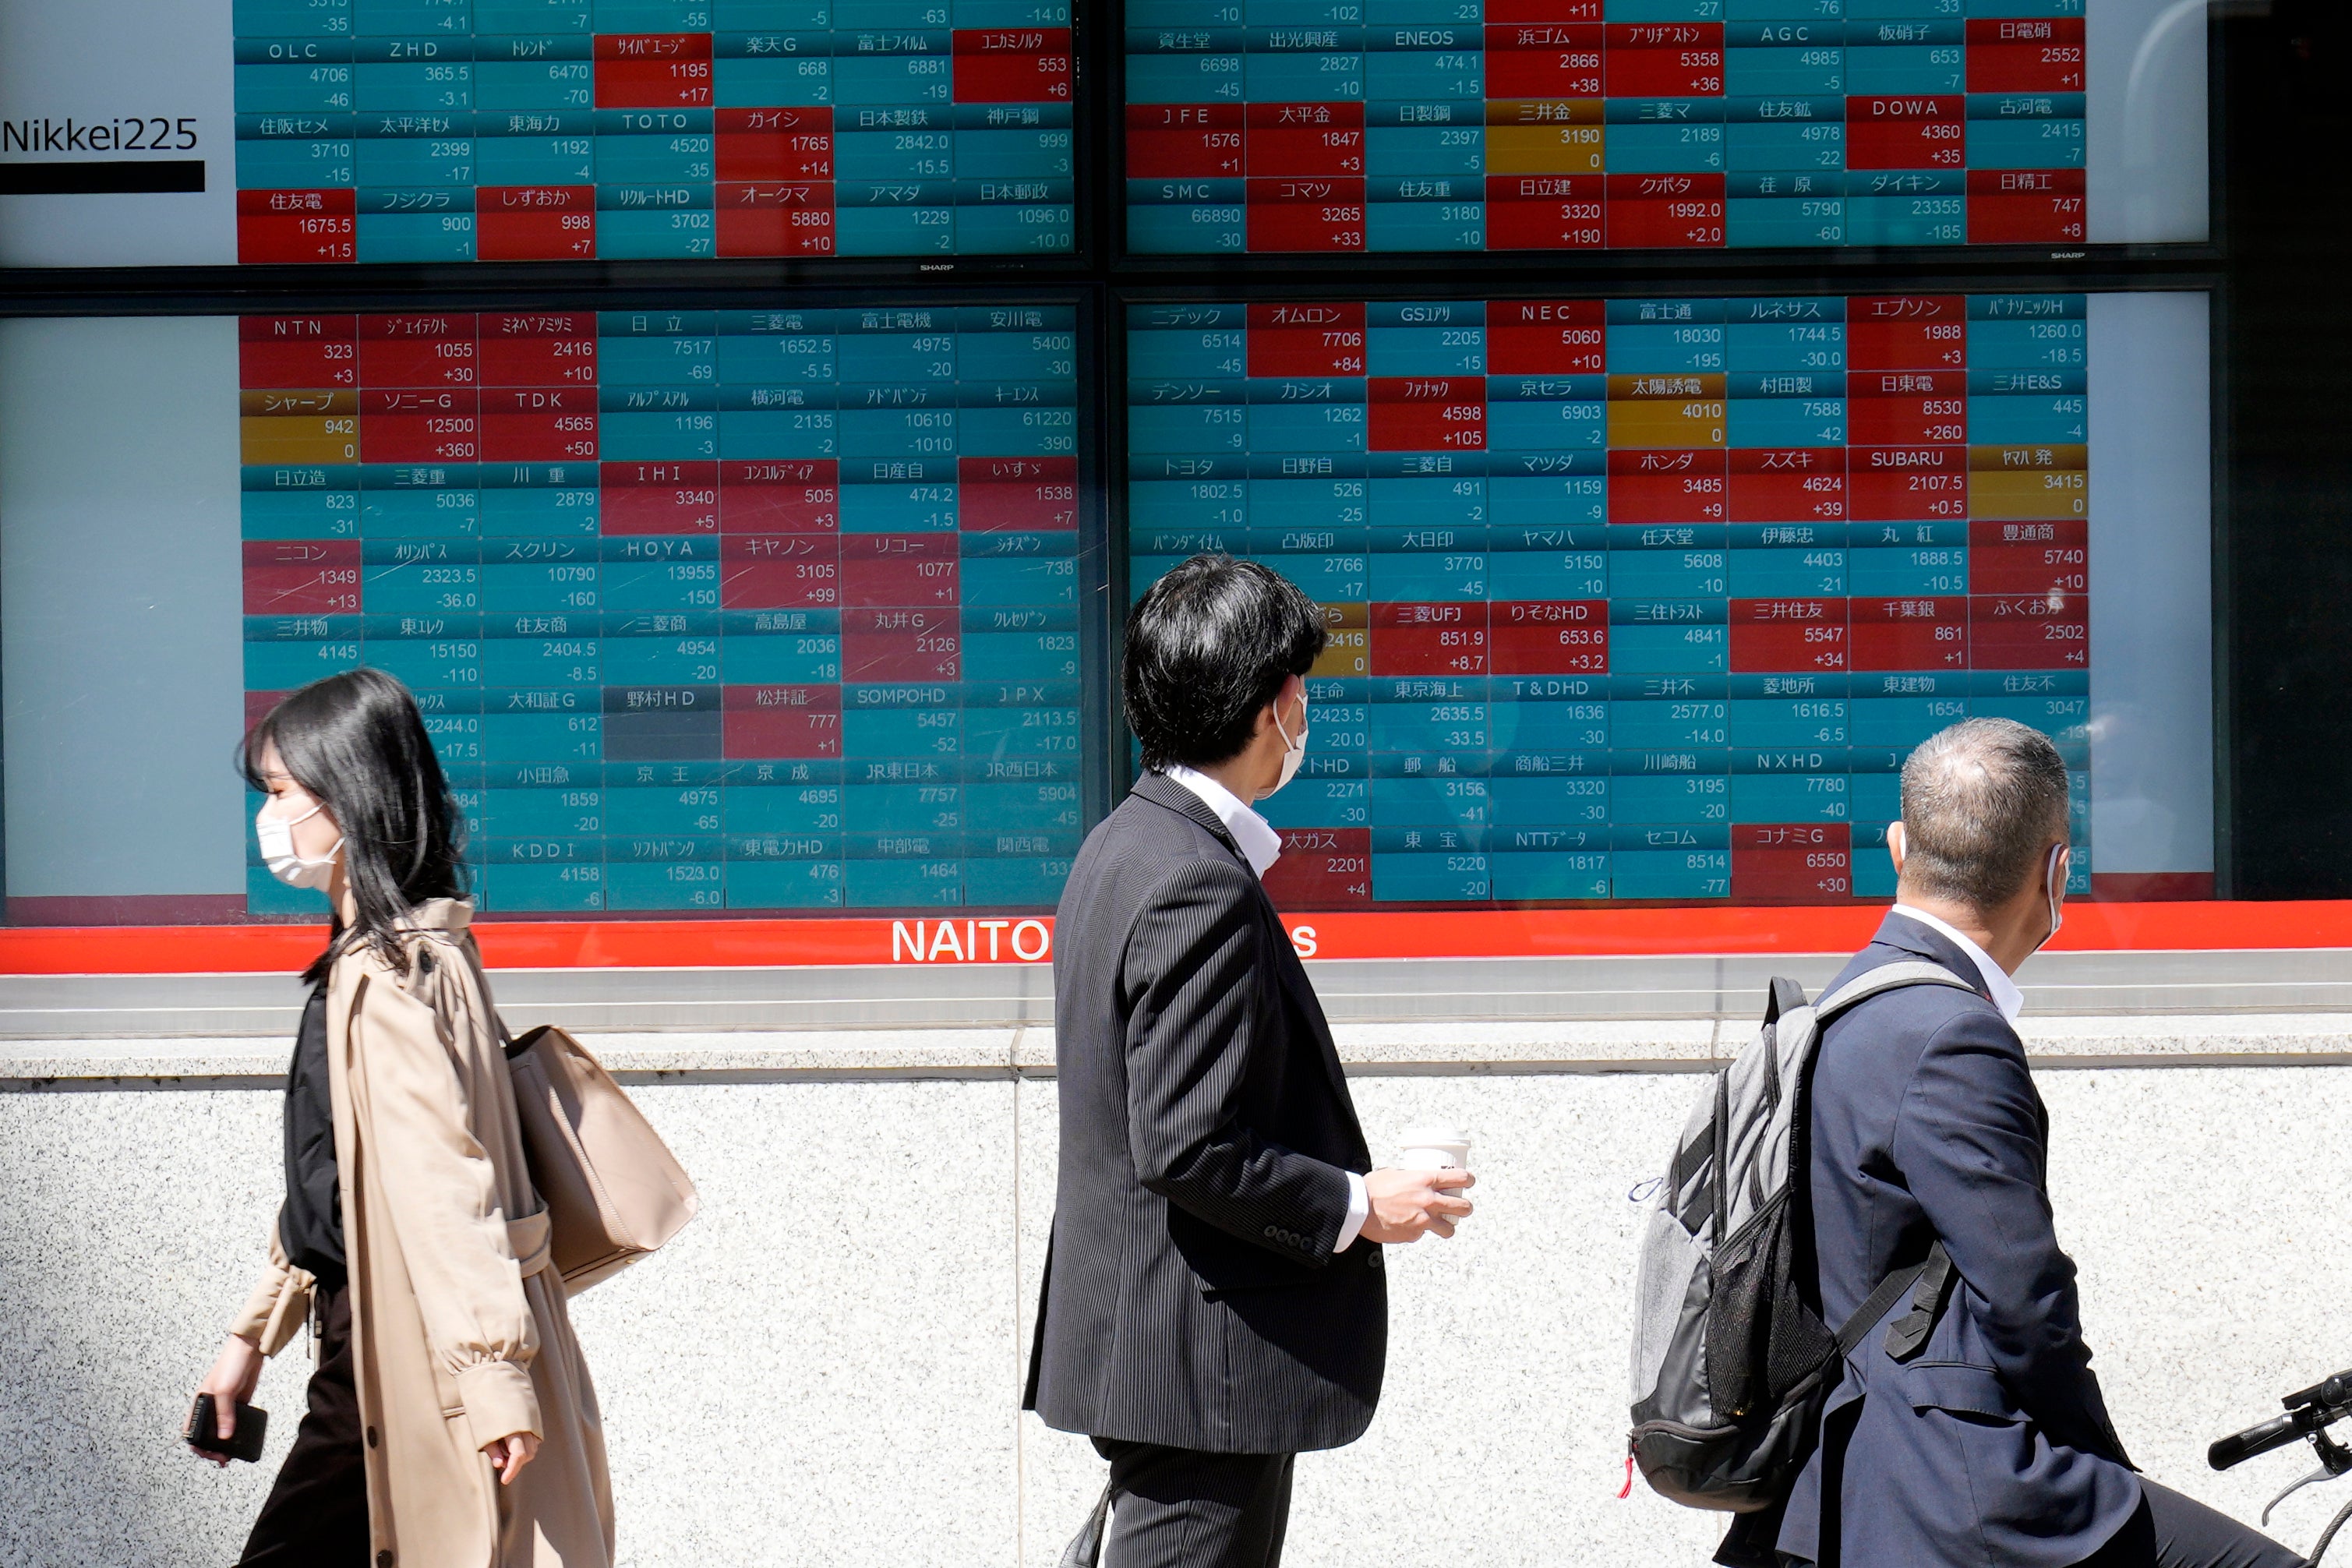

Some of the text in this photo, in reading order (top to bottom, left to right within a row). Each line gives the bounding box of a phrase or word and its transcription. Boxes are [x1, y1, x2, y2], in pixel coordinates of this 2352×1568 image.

[1213, 7, 1239, 22] -10
[1693, 1, 1718, 16] -27
[682, 12, 708, 27] -55
[1395, 30, 1454, 46] ENEOS
[1517, 27, 1570, 45] 浜ゴム
[1877, 24, 1930, 41] 板硝子
[2000, 22, 2051, 39] 日電硝
[747, 36, 796, 54] 楽天G
[1158, 32, 1210, 49] 資生堂
[1270, 30, 1338, 48] 出光興産
[1680, 51, 1719, 67] 5358
[2041, 48, 2080, 63] 2552
[798, 61, 827, 76] 668
[1320, 56, 1359, 72] 2827
[425, 65, 468, 81] 365.5
[1449, 79, 1479, 94] -1.5
[439, 91, 467, 106] -3.1
[2000, 98, 2053, 115] 古河電
[1519, 102, 1571, 121] 三井金
[1758, 101, 1812, 118] 住友鉱
[1873, 100, 1938, 115] DOWA
[747, 111, 800, 129] ガイシ
[860, 109, 928, 127] 日本製鉄
[986, 108, 1039, 125] 神戸鋼
[259, 118, 328, 135] 住阪セメ
[1801, 126, 1841, 141] 4978
[3, 118, 197, 152] Nikkei225
[1039, 133, 1068, 148] 999
[1440, 130, 1479, 146] 2397
[311, 143, 350, 158] 3710
[669, 138, 709, 153] 4520
[1931, 149, 1961, 164] +35
[325, 167, 350, 182] -15
[2001, 173, 2052, 190] 日精工
[1280, 182, 1331, 198] コマツ
[1398, 181, 1451, 198] 住友重
[1520, 178, 1571, 196] 日立建
[1640, 176, 1691, 194] クボタ
[1870, 174, 1941, 192] ダイキン
[503, 189, 571, 207] しずおか
[740, 186, 810, 203] オークマ
[870, 185, 920, 202] アマダ
[980, 183, 1048, 200] 日本郵政
[269, 192, 323, 210] 住友電
[383, 192, 450, 209] フジクラ
[1912, 200, 1961, 215] 23355
[912, 210, 950, 225] 1229
[1191, 208, 1241, 223] 66890
[1561, 203, 1601, 220] 3320
[561, 215, 591, 230] 998
[1686, 227, 1721, 242] +2.0
[317, 242, 351, 258] +1.5
[1271, 306, 1341, 324] オムロン
[1640, 302, 1693, 320] 富士通
[1871, 298, 1941, 316] エプソン
[750, 313, 803, 330] 三菱電
[861, 312, 931, 329] 富士電機
[991, 310, 1043, 327] 安川電
[1673, 328, 1721, 343] 18030
[2029, 323, 2082, 339] 1260.0
[779, 338, 832, 354] 1652.5
[1322, 332, 1361, 347] 7706
[435, 342, 473, 358] 1055
[1332, 356, 1361, 372] +84
[1801, 351, 1841, 366] -30.0
[563, 366, 593, 381] +10
[1281, 382, 1333, 399] カシオ
[1520, 380, 1572, 397] 京セラ
[1631, 377, 1702, 395] 太陽誘電
[1760, 376, 1812, 394] 村田製
[1882, 374, 1934, 393] 日東電
[750, 389, 804, 406] 横河電
[1153, 383, 1221, 401] デンソー
[384, 394, 451, 409] ソニーG
[1803, 402, 1842, 417] 7588
[1022, 411, 1072, 426] 61220
[1442, 405, 1481, 421] 4598
[324, 418, 354, 434] 942
[675, 415, 713, 430] 1196
[1923, 425, 1962, 440] +260
[435, 442, 475, 457] +360
[1166, 458, 1213, 475] トヨタ
[1282, 457, 1332, 474] 日野自
[1401, 454, 1452, 473] 三菱自
[1523, 454, 1573, 472] マツダ
[1640, 452, 1694, 470] ホンダ
[1760, 450, 1813, 468] スズキ
[1871, 451, 1943, 467] SUBARU
[275, 469, 327, 486] 日立造
[394, 468, 447, 485] 三菱重
[874, 461, 923, 479] 日産自
[1565, 480, 1602, 495] 1159
[1909, 475, 1963, 491] 2107.5
[676, 490, 715, 505] 3340
[1035, 486, 1073, 500] 1538
[1191, 484, 1242, 500] 1802.5
[1928, 500, 1963, 514] +0.5
[330, 519, 353, 534] -31
[2003, 523, 2054, 541] 豊通商
[1282, 531, 1334, 549] 凸版印
[1523, 530, 1575, 546] ヤマハ
[1640, 528, 1694, 546] 任天堂
[1760, 527, 1814, 545] 伊藤忠
[505, 542, 575, 559] スクリン
[745, 539, 814, 556] キヤノン
[1564, 555, 1603, 570] 5150
[1911, 550, 1963, 566] 1888.5
[916, 562, 955, 577] 1077
[1817, 577, 1841, 592] -21
[680, 589, 716, 605] -150
[1397, 606, 1461, 623] 三菱UFJ
[1511, 605, 1587, 621] りそなHD
[1753, 602, 1823, 620] 三井住友
[515, 616, 567, 634] 住友商
[1559, 630, 1604, 645] 653.6
[1934, 626, 1962, 641] 861
[542, 641, 596, 657] 2404.5
[810, 663, 836, 679] -18
[1644, 679, 1695, 696] 三井不
[1763, 676, 1815, 694] 菱地所
[1882, 676, 1935, 694] 東建物
[508, 691, 575, 709] 大和証G
[857, 687, 945, 704] SOMPOHD
[1566, 705, 1605, 720] 1636
[568, 715, 599, 732] 612
[1444, 730, 1489, 747] -33.5
[1644, 754, 1697, 771] 川崎船
[517, 765, 570, 785] 小田急
[1446, 781, 1487, 797] 3156
[1806, 777, 1845, 793] 7780
[560, 792, 599, 807] 1859
[1038, 785, 1078, 802] 5904
[813, 813, 839, 828] -20
[1459, 806, 1484, 821] -41
[1757, 828, 1824, 844] コナミG
[1686, 854, 1725, 869] 8514
[808, 863, 840, 881] 476
[1460, 881, 1486, 896] -20
[892, 920, 1050, 961] NAITO
